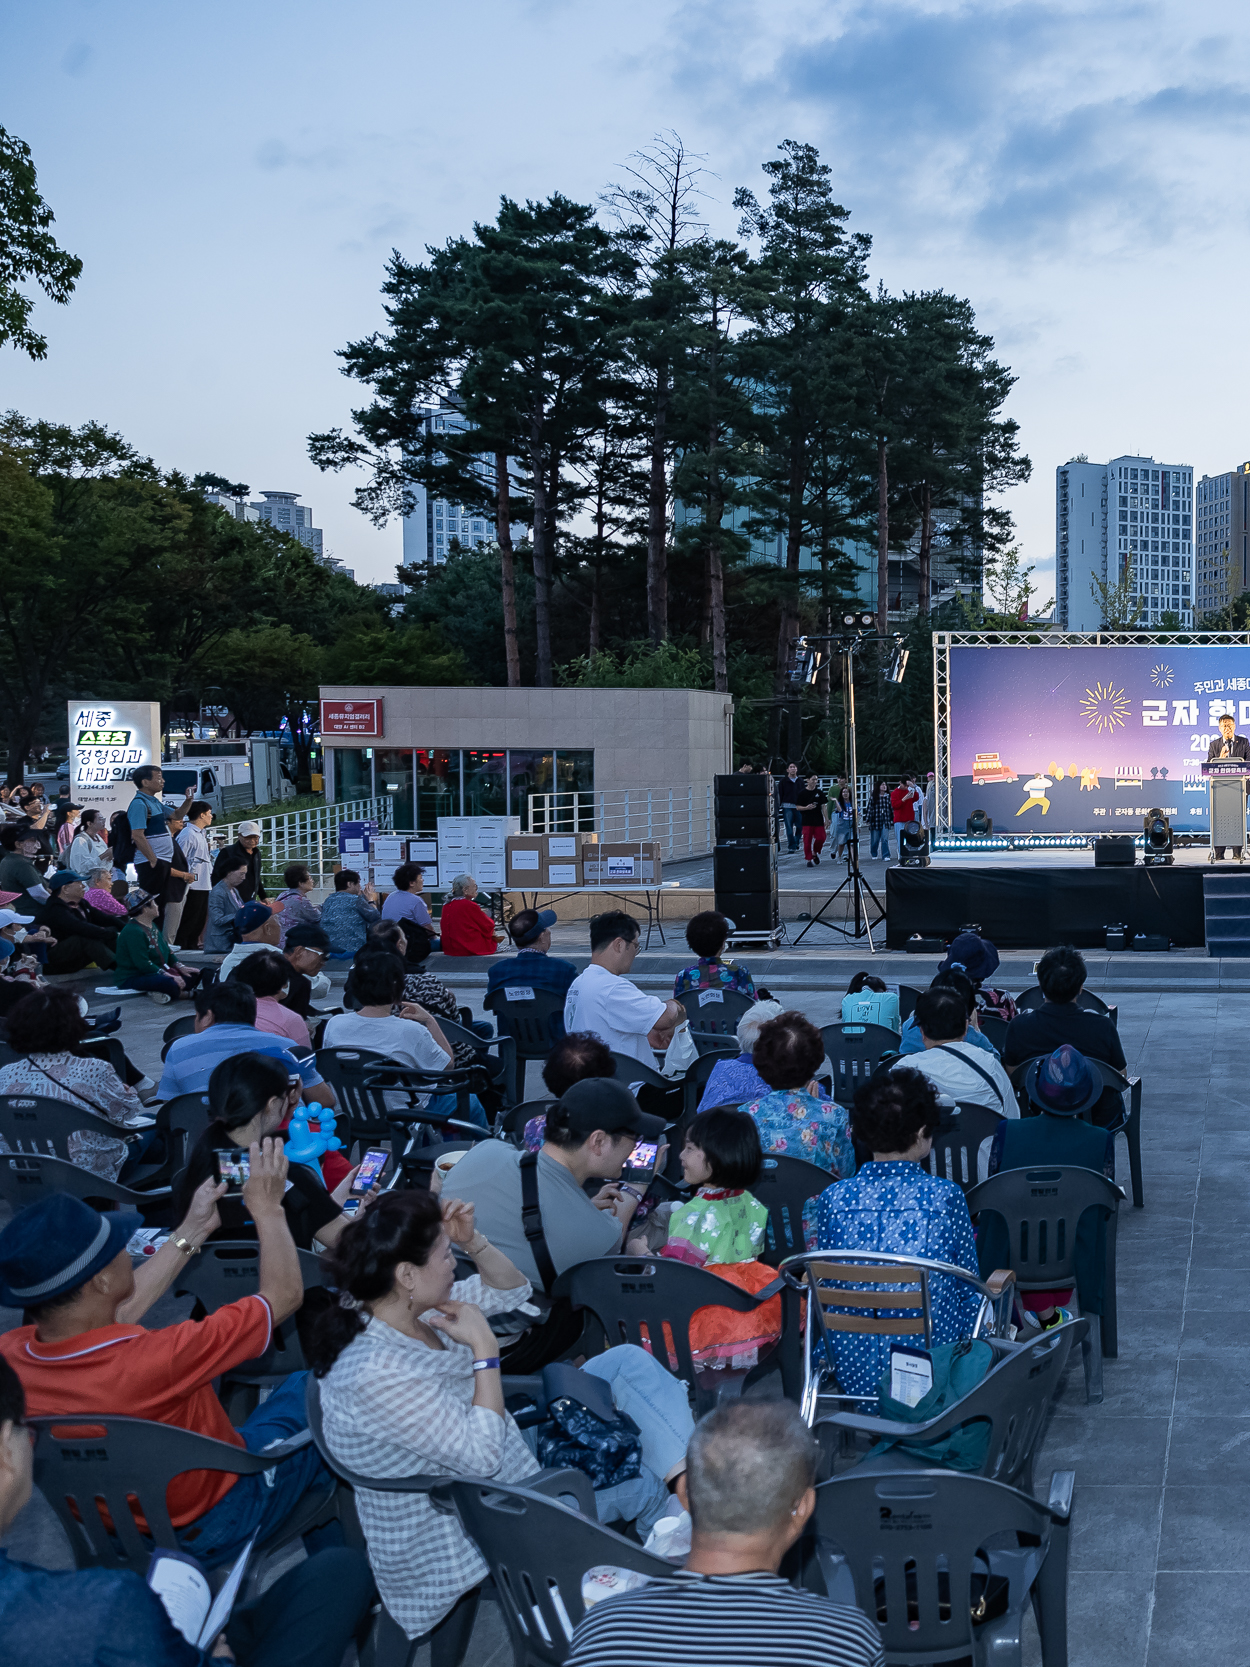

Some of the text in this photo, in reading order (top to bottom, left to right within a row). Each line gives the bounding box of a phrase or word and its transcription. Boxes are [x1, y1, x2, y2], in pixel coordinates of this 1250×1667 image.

[1193, 678, 1224, 695] 주민과
[75, 710, 112, 728] 세종
[1141, 698, 1200, 727] 군자
[79, 730, 127, 745] 스포츠
[76, 749, 142, 765] 정형외과
[1093, 807, 1107, 816] 주관
